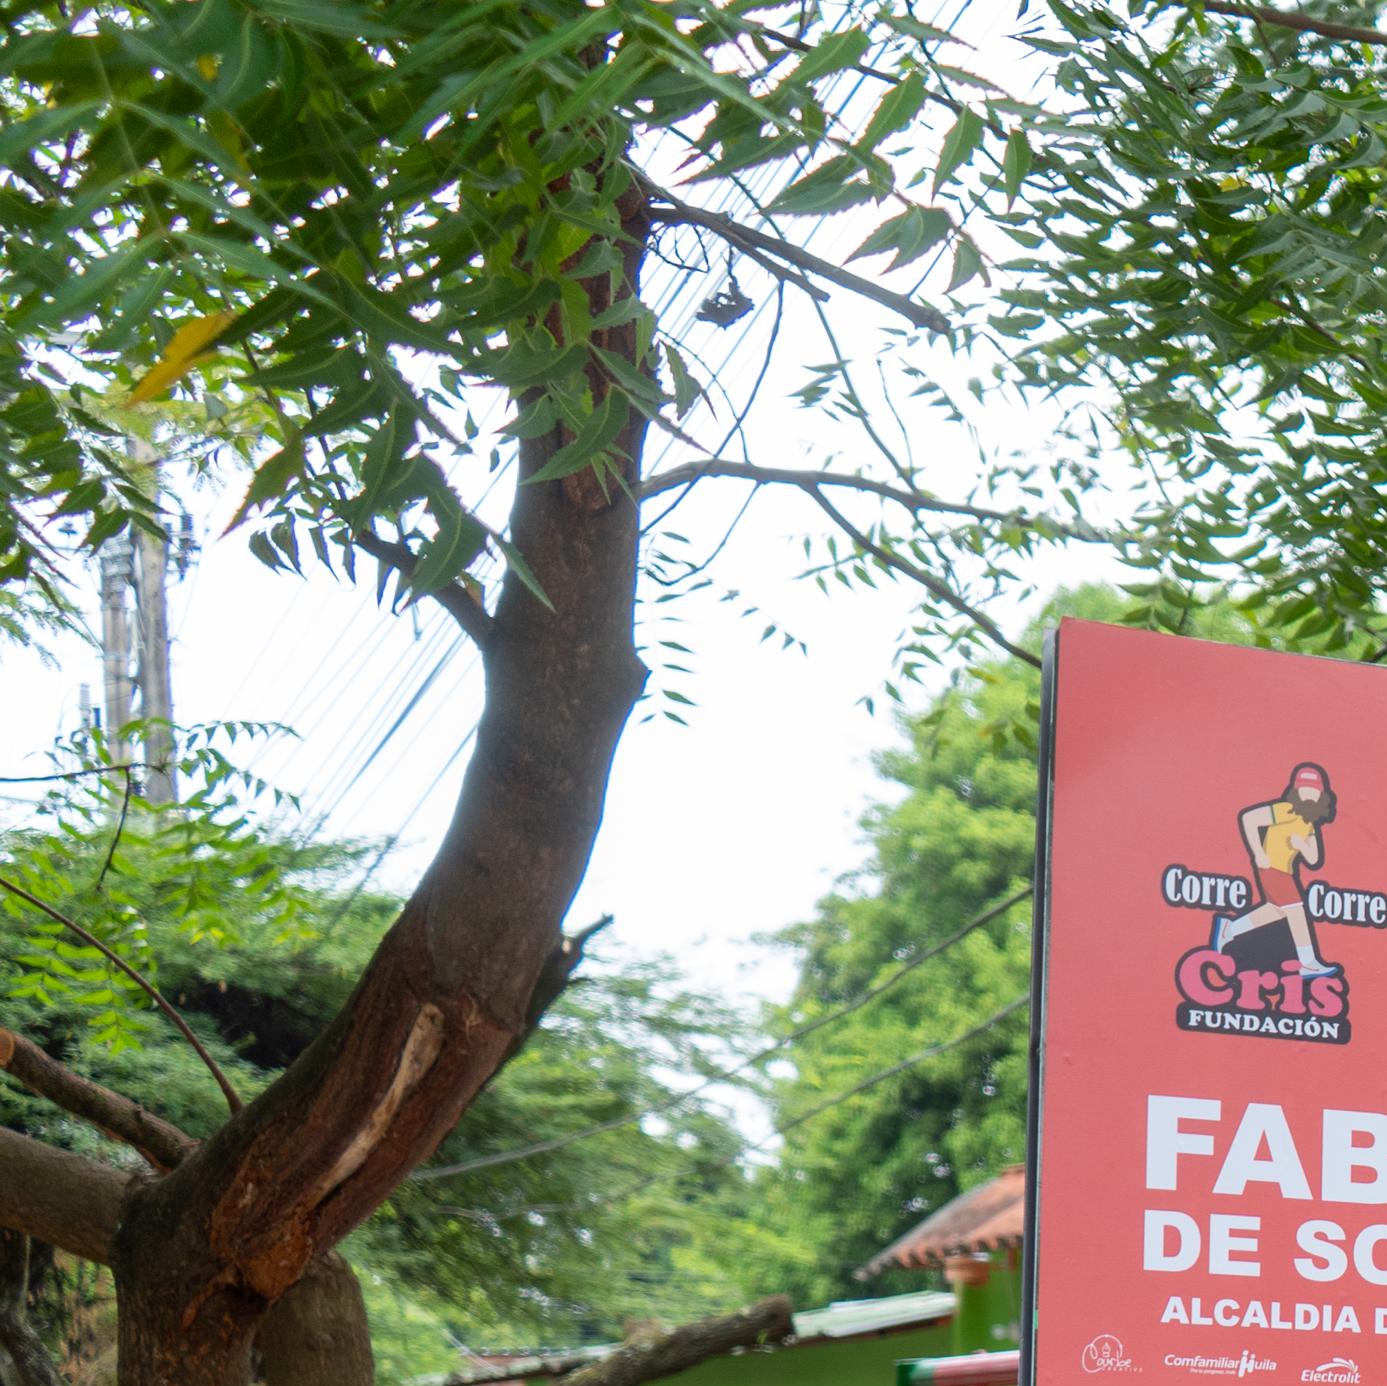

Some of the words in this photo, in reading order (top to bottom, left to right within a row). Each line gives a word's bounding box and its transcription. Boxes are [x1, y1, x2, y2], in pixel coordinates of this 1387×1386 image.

[1165, 868, 1247, 909] Corre
[1308, 884, 1386, 924] Corre
[1179, 950, 1343, 1017] Cris
[1188, 1010, 1340, 1039] FUNDACIÓN
[1143, 1209, 1261, 1277] DE
[1161, 1296, 1361, 1334] ALCALDIA
[1301, 1369, 1361, 1384] Electrolit
